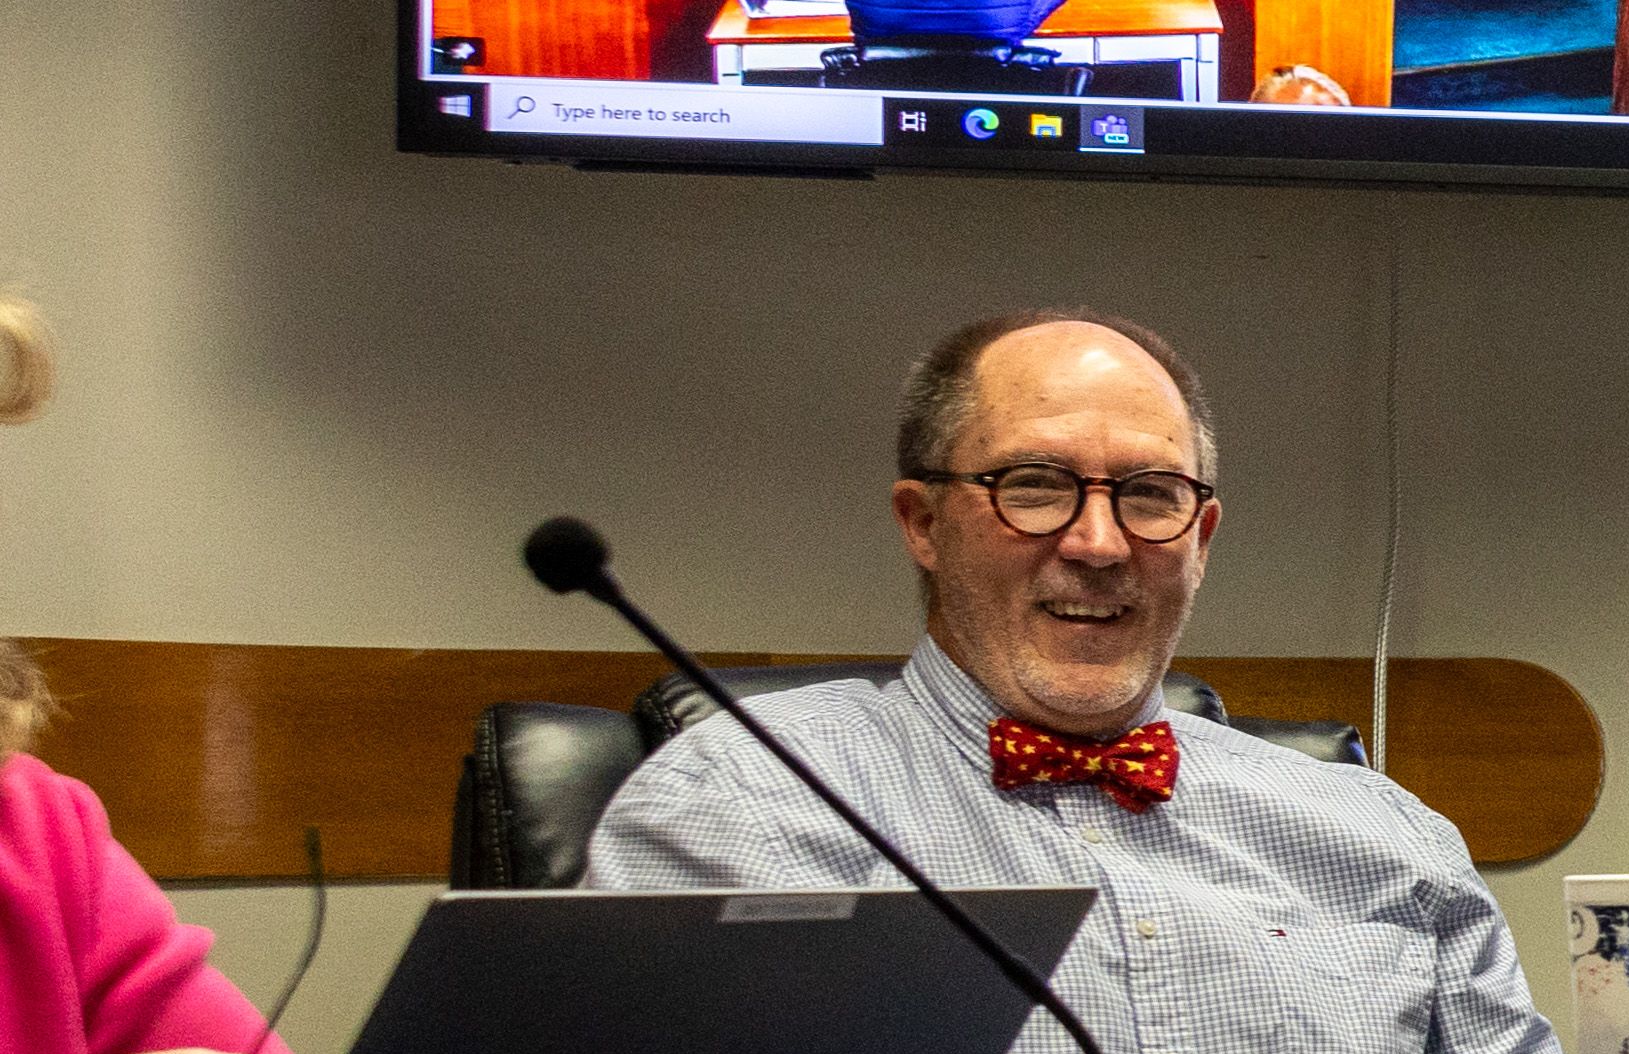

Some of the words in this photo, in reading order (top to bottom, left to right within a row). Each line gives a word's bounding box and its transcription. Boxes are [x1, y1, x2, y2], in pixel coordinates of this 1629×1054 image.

[552, 102, 595, 122] Type
[601, 104, 642, 120] here
[648, 109, 667, 121] to
[672, 108, 731, 123] search
